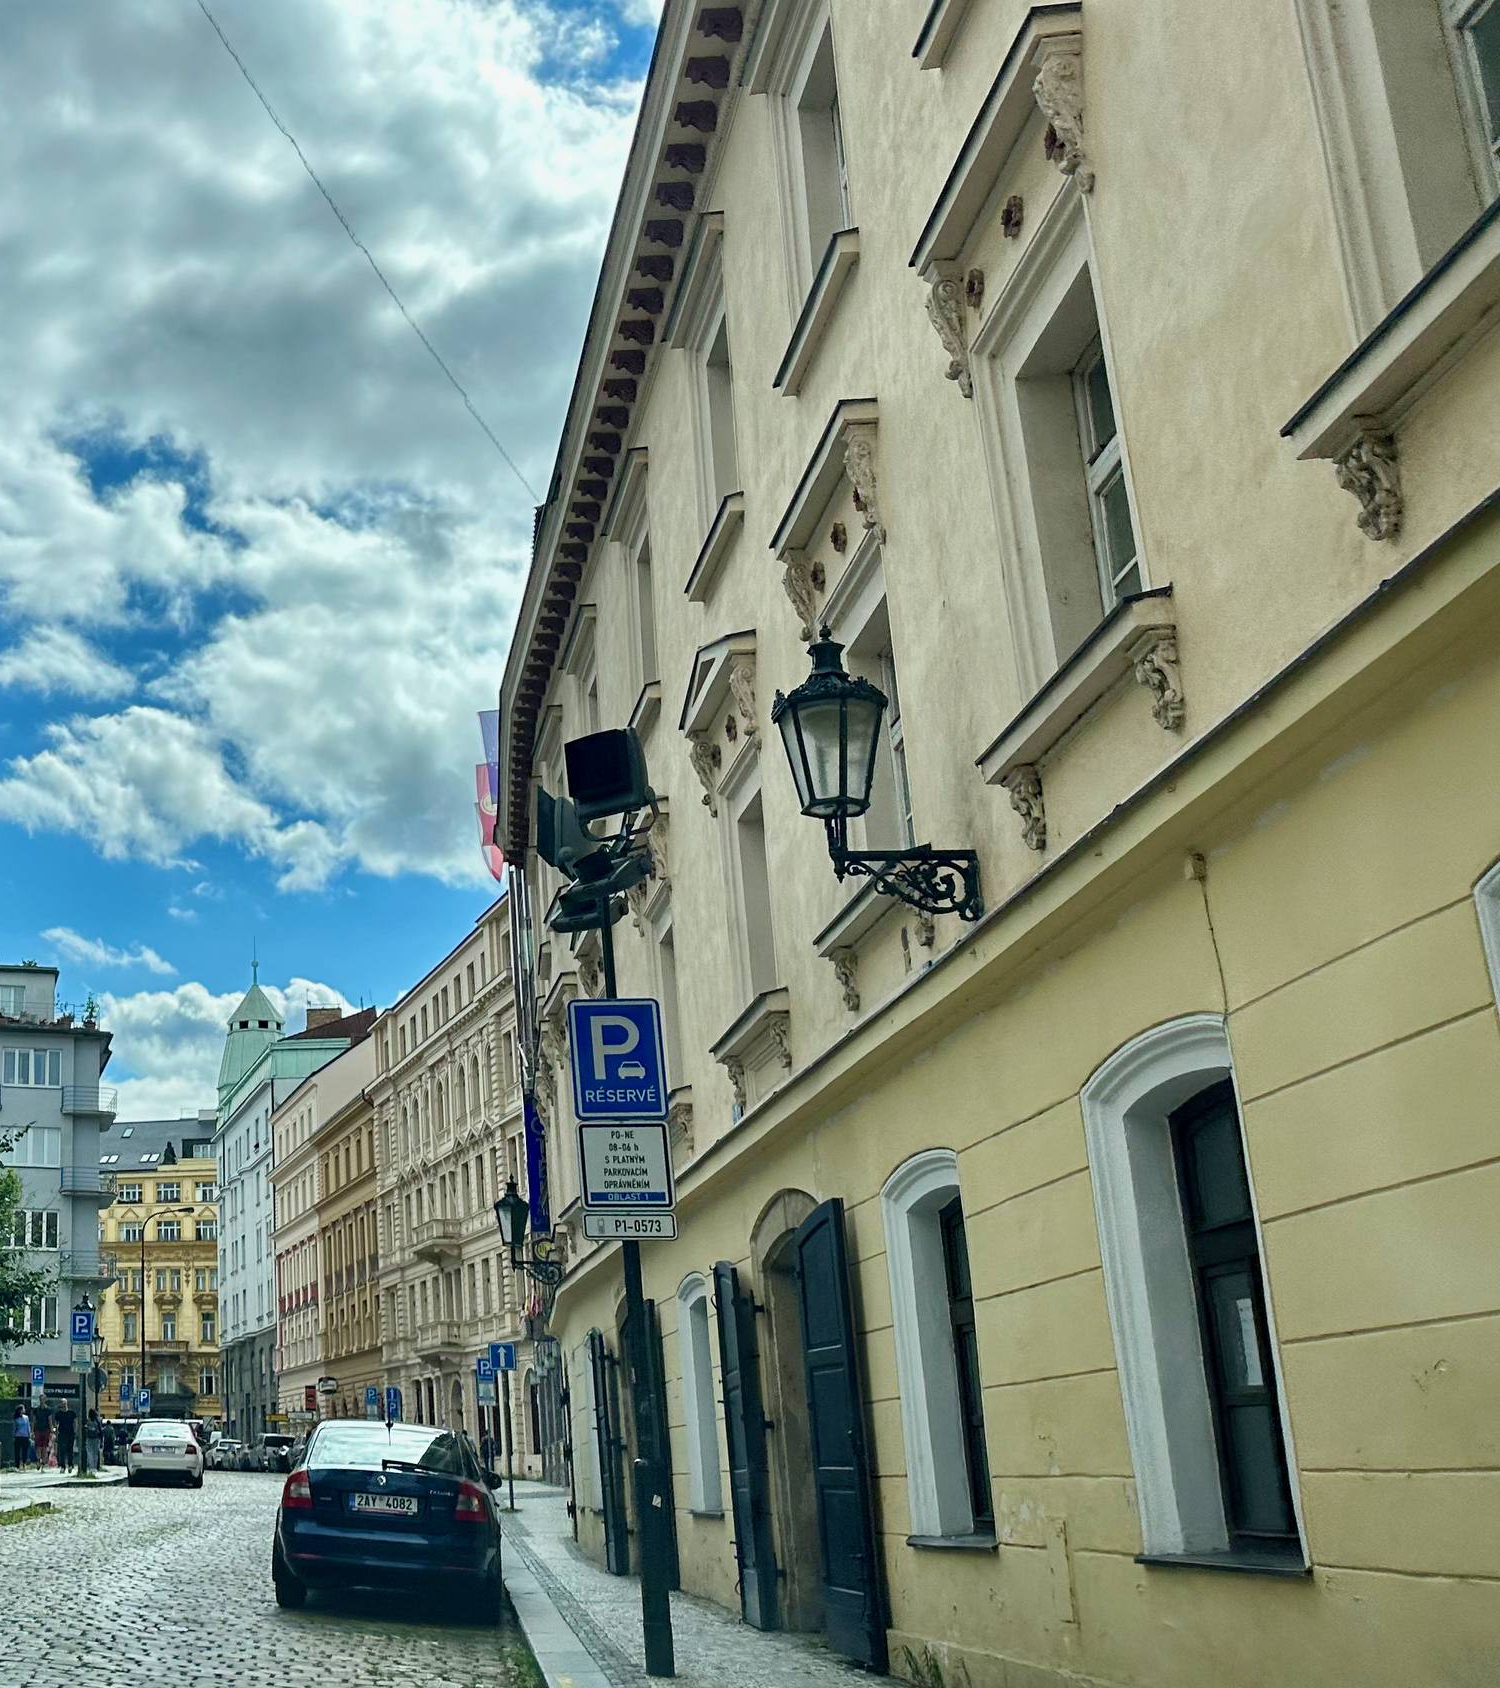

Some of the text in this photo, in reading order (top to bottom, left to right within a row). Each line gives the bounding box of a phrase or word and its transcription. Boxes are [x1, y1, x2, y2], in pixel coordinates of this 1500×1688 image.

[590, 1015, 640, 1080] P
[585, 1085, 657, 1103] RÉSERVÉ
[610, 1130, 635, 1139] PO-NE
[608, 1143, 639, 1152] 08-06 h
[604, 1154, 645, 1164] S PLATNÝM
[603, 1166, 648, 1177] PARKOVACÍM
[604, 1179, 650, 1189] OPRÁVNĚNÍM
[614, 1219, 662, 1233] P1-0573
[75, 1315, 88, 1334] P
[34, 1368, 42, 1379] P
[480, 1360, 490, 1375] P
[140, 1391, 148, 1403] P
[357, 1495, 413, 1511] 2AY 4082
